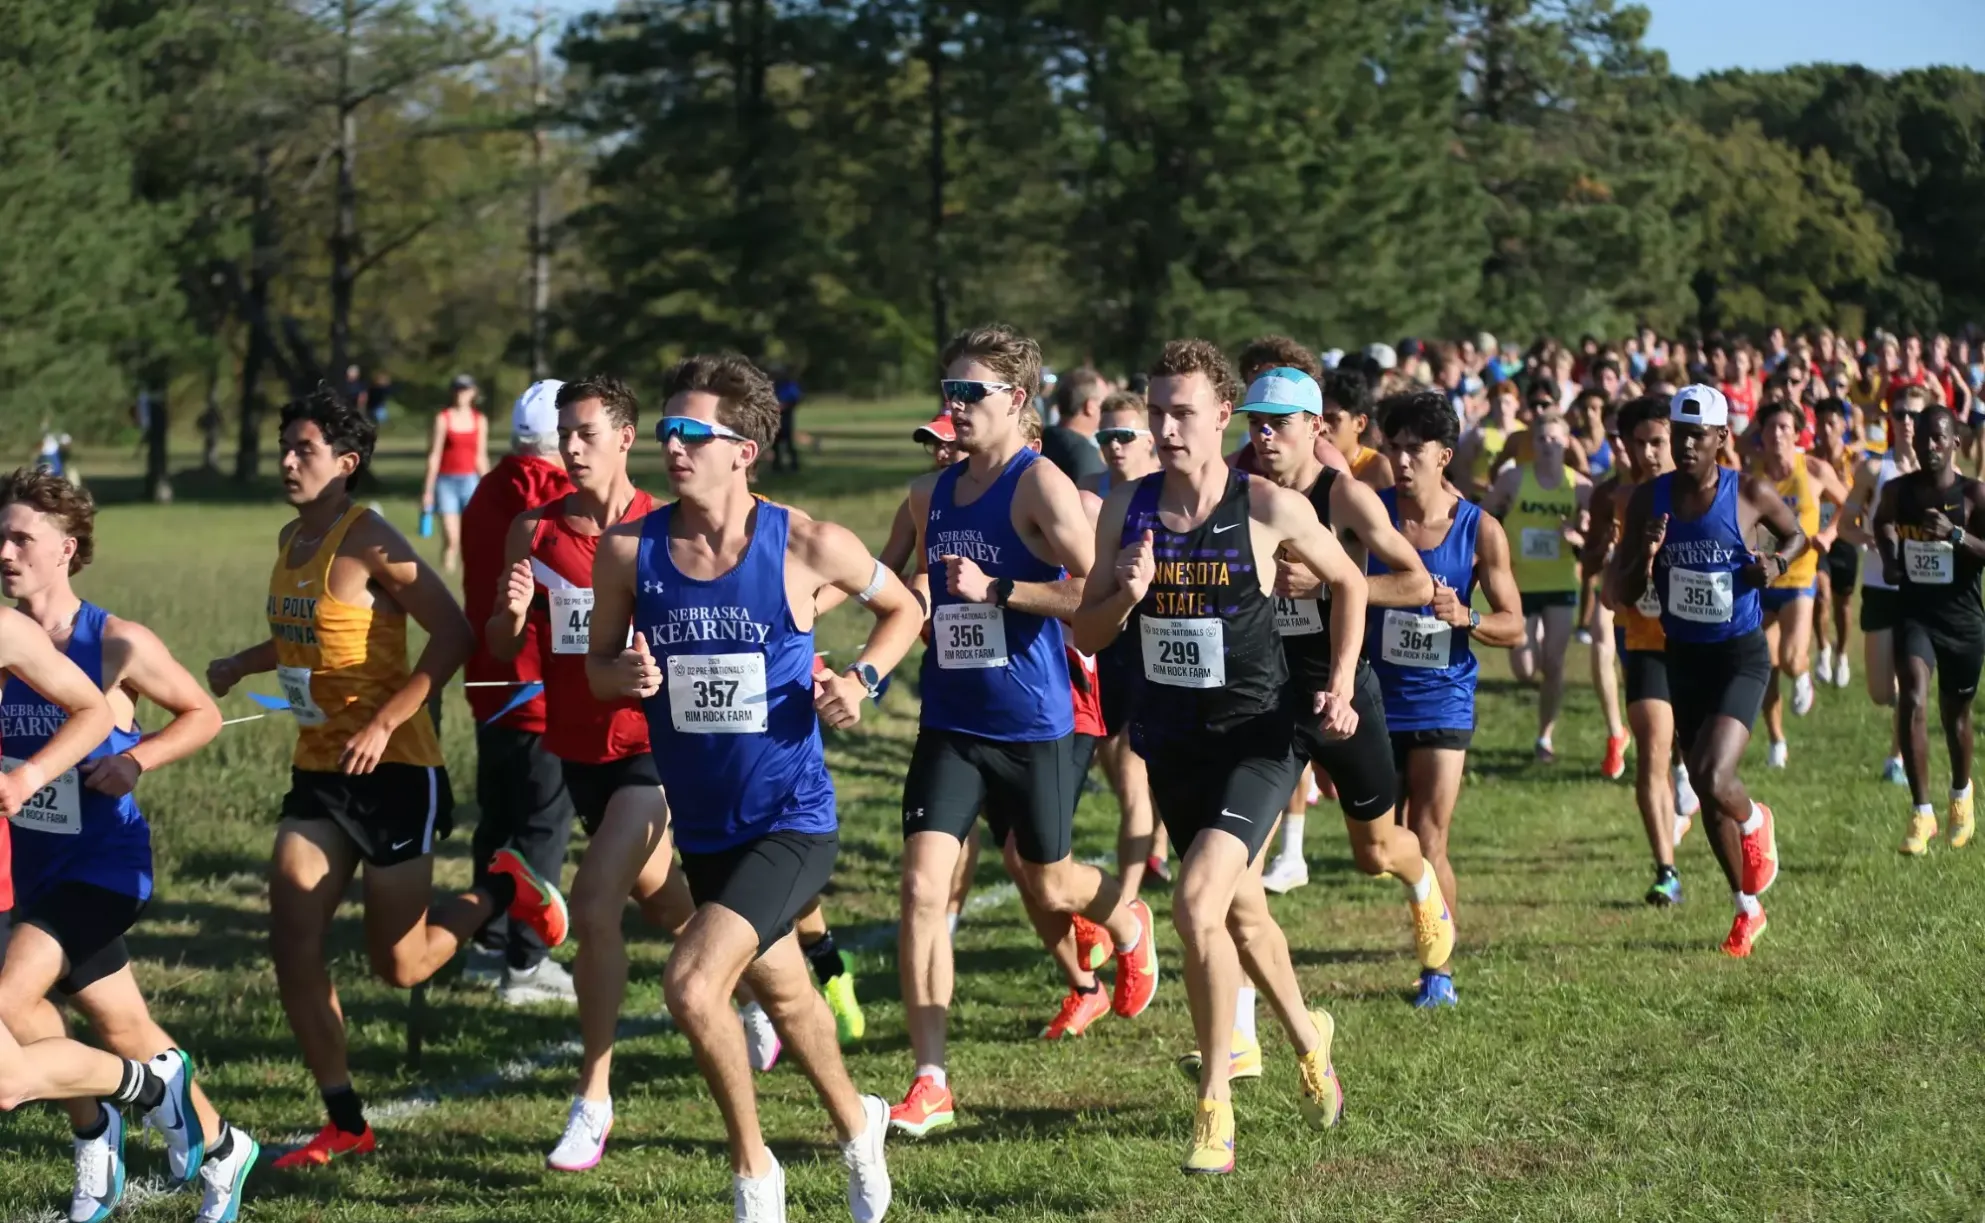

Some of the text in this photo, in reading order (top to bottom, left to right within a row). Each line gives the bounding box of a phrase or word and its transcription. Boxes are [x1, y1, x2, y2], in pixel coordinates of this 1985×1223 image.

[938, 529, 985, 543] NEBRASKA
[1914, 554, 1940, 570] 325
[1152, 561, 1230, 586] NNESOTA
[1156, 591, 1207, 616] STATE
[1684, 586, 1714, 606] 351
[282, 597, 317, 619] POLY
[668, 606, 750, 622] NEBRASKA
[1272, 597, 1299, 616] 41
[1705, 607, 1723, 616] FARM
[951, 612, 988, 621] PRE-NATIONALS
[1291, 617, 1311, 628] FARM
[561, 634, 575, 645] RIM
[651, 619, 771, 646] KEARNEY
[949, 624, 985, 648] 356
[1151, 627, 1204, 638] D2 PRE-NATIONALS
[1400, 629, 1433, 652] 364
[944, 648, 996, 661] RIM ROCK FARM
[1158, 640, 1200, 666] 299
[1390, 647, 1440, 661] RIM ROCK FARM
[687, 665, 745, 676] D2 PRE-NATIONALS
[1153, 663, 1212, 679] RIM ROCK FARM
[693, 680, 739, 708] 357
[685, 710, 753, 722] RIM ROCK FARM
[22, 785, 58, 811] 52
[26, 808, 46, 822] ROCK
[46, 812, 68, 825] FARM
